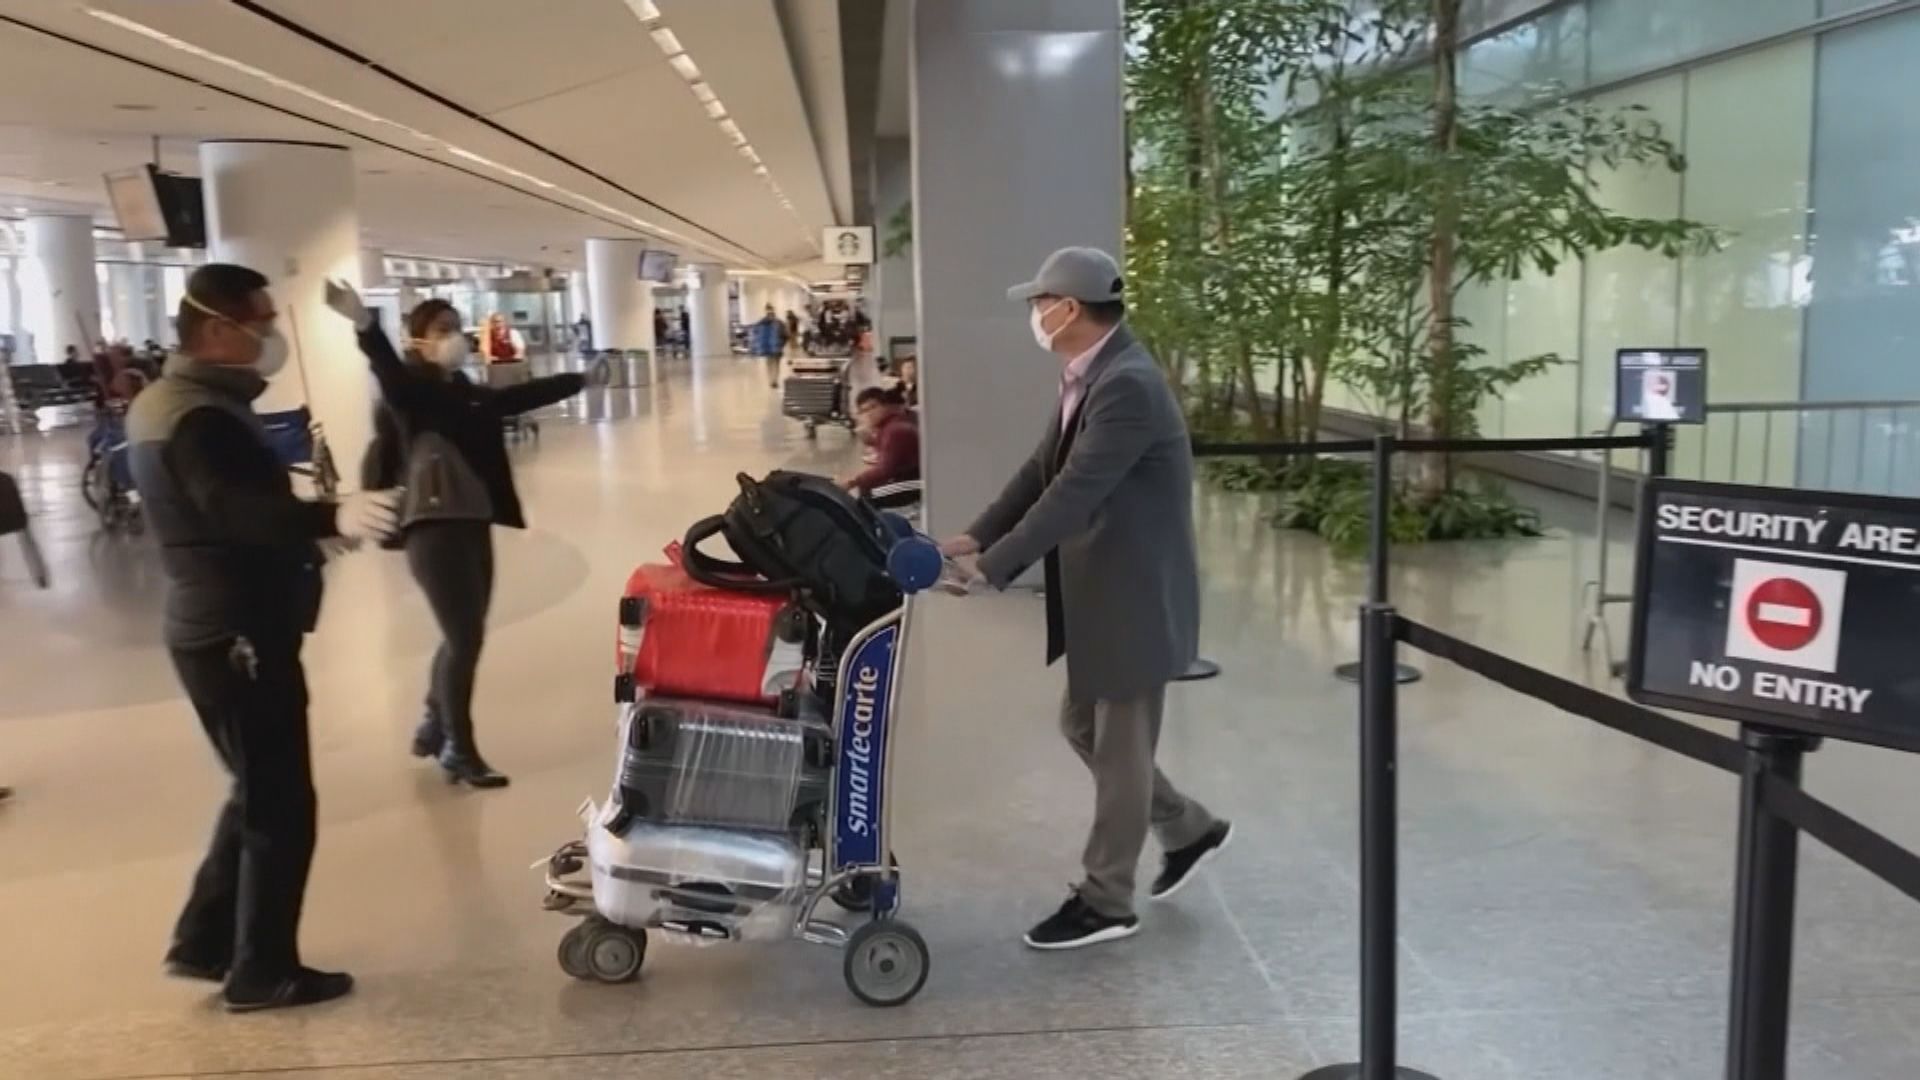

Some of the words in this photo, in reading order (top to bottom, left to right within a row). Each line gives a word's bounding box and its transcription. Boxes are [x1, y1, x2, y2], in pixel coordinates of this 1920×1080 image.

[1657, 503, 1828, 544] SECURITY
[1837, 522, 1920, 555] ARE
[1689, 661, 1741, 692] NO
[1752, 671, 1872, 714] ENTRY
[847, 665, 879, 837] smartecarte
